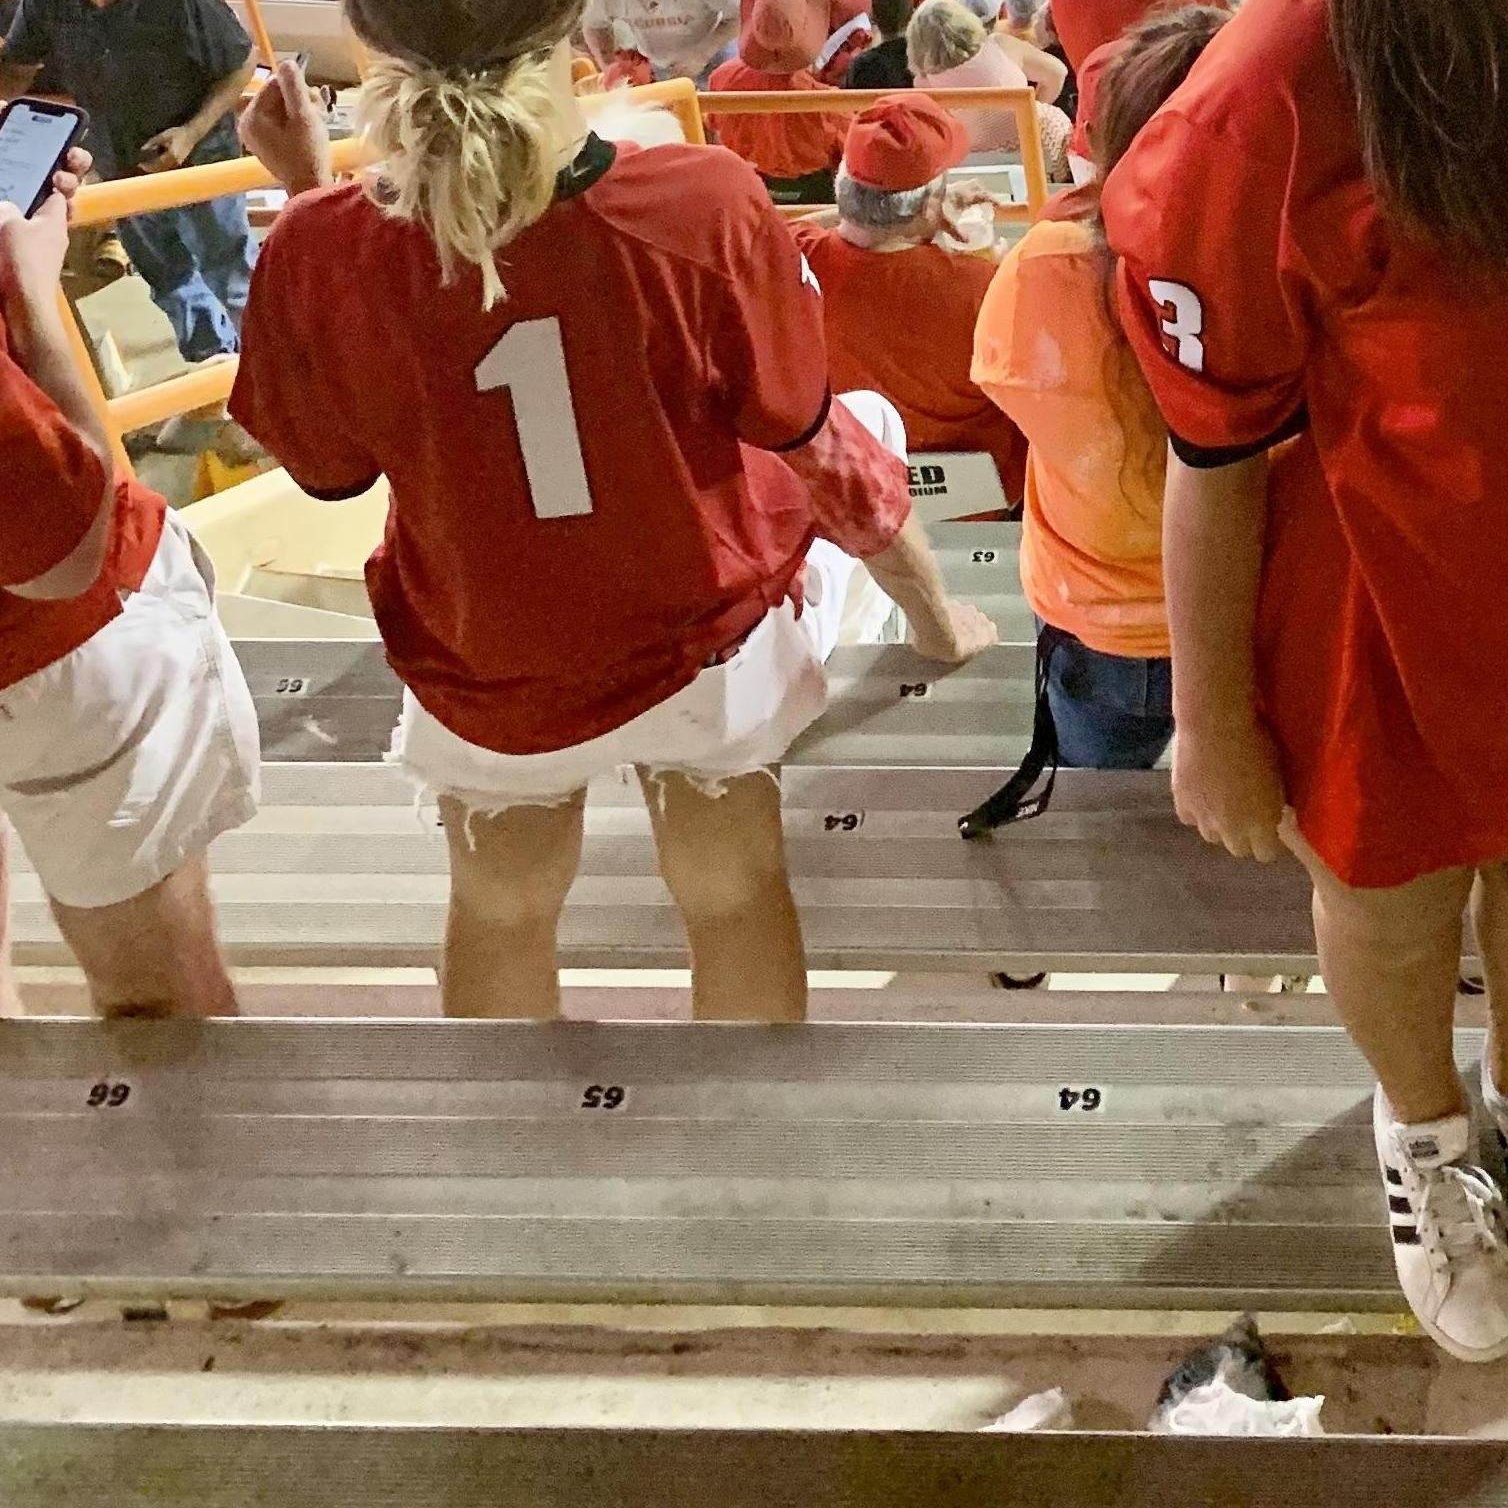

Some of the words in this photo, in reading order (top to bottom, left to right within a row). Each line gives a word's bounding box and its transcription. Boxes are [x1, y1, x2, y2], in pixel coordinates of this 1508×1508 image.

[1148, 279, 1204, 373] 3
[473, 315, 594, 519] 1
[971, 551, 996, 563] 63
[900, 682, 928, 697] 64
[824, 814, 858, 831] 64
[86, 1083, 131, 1108] 66
[581, 1085, 626, 1109] 65
[1058, 1087, 1102, 1112] 64
